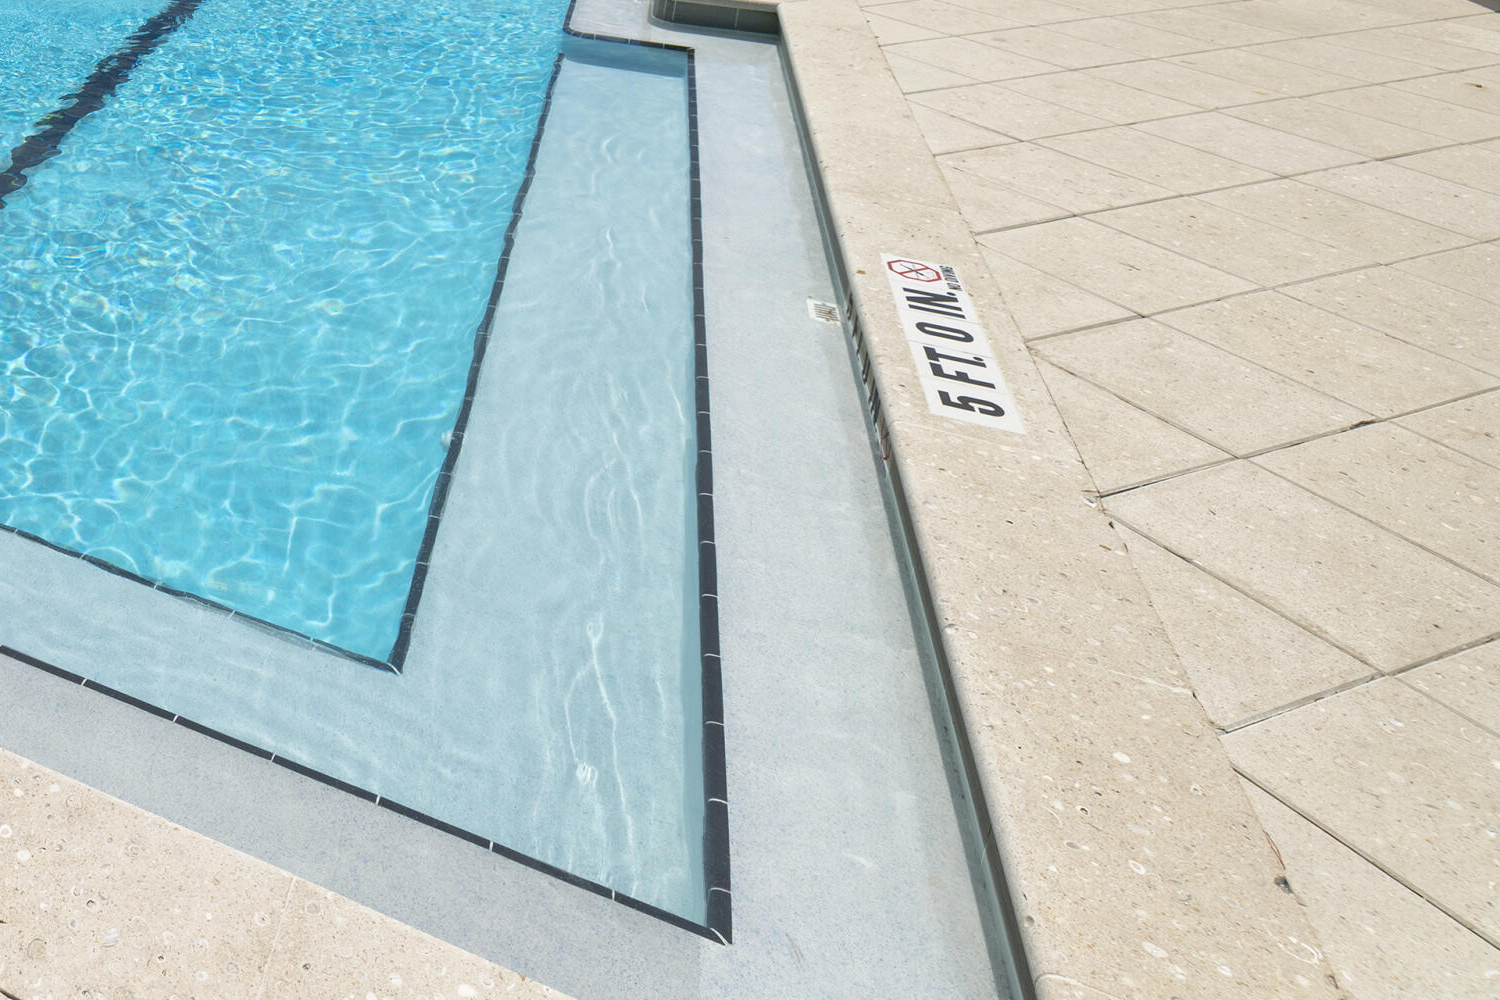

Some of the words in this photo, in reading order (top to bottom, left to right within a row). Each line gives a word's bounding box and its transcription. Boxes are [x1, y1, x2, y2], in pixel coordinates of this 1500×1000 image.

[902, 287, 966, 319] IN.
[923, 345, 996, 389] FT.
[937, 390, 1005, 417] 5
